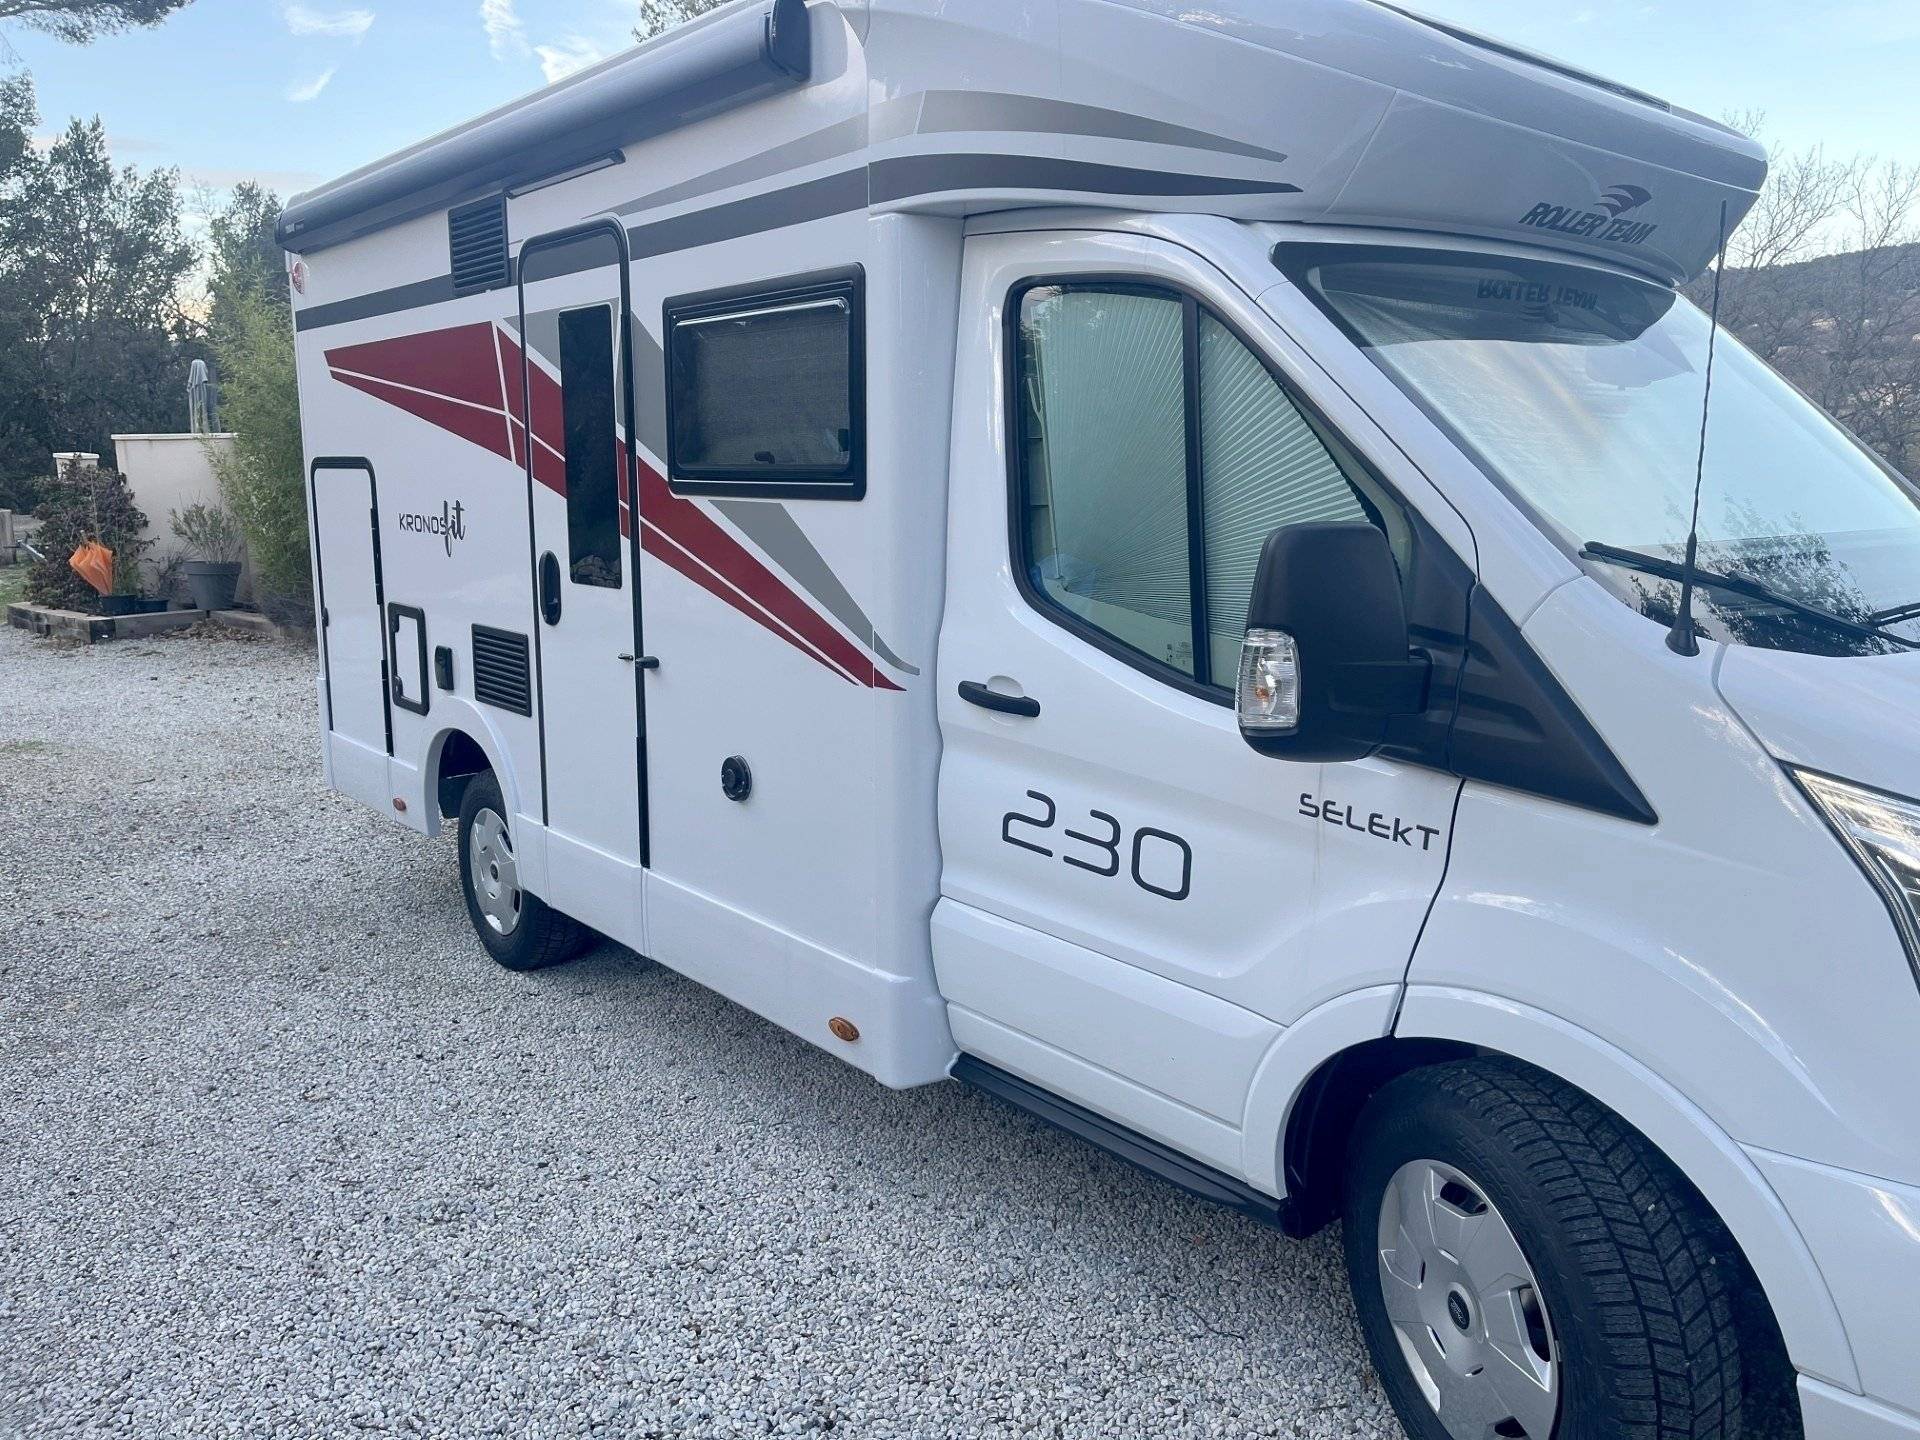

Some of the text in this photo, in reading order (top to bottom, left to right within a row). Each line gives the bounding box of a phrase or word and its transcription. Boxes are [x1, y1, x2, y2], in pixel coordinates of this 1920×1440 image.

[1518, 202, 1658, 244] ROLLER TEAM
[1002, 789, 1192, 901] 230
